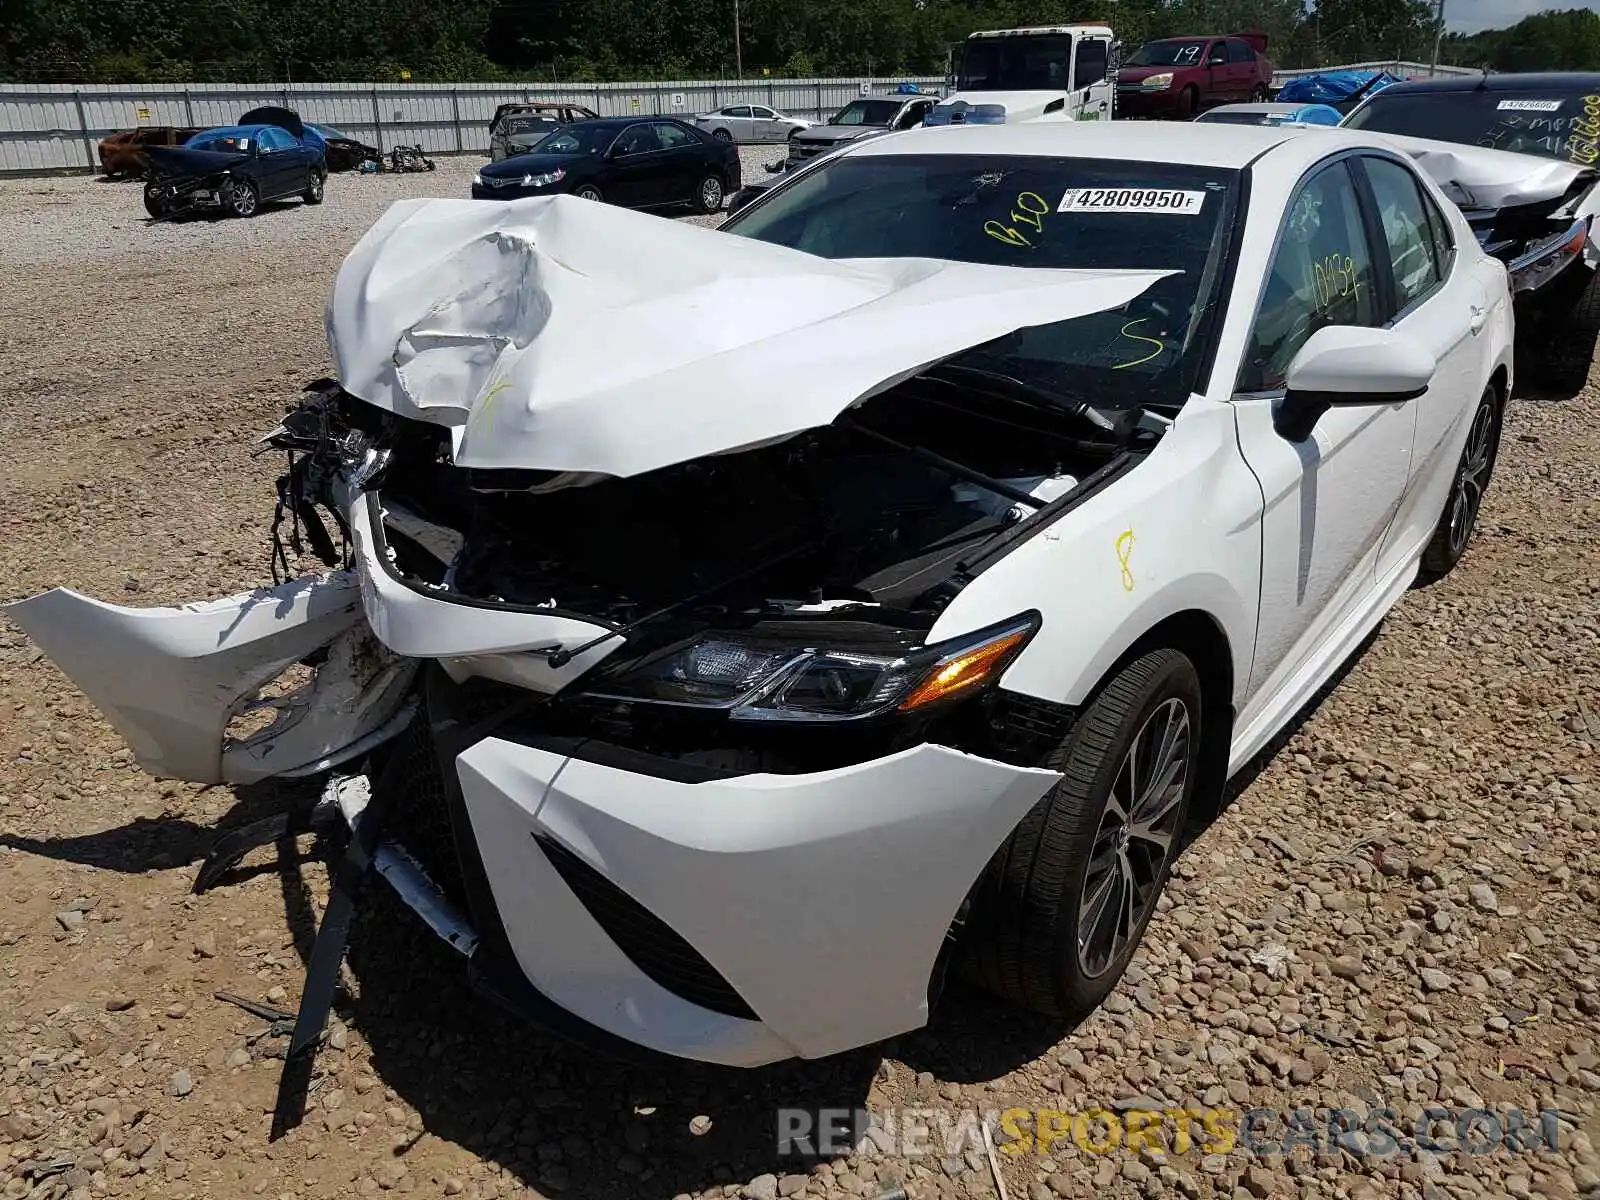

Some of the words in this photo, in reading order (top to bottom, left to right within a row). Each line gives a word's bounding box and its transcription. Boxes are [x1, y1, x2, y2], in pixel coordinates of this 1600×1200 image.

[1173, 46, 1199, 61] 19
[1076, 190, 1185, 208] 42809950
[1185, 198, 1195, 208] F
[1115, 529, 1134, 592] 8
